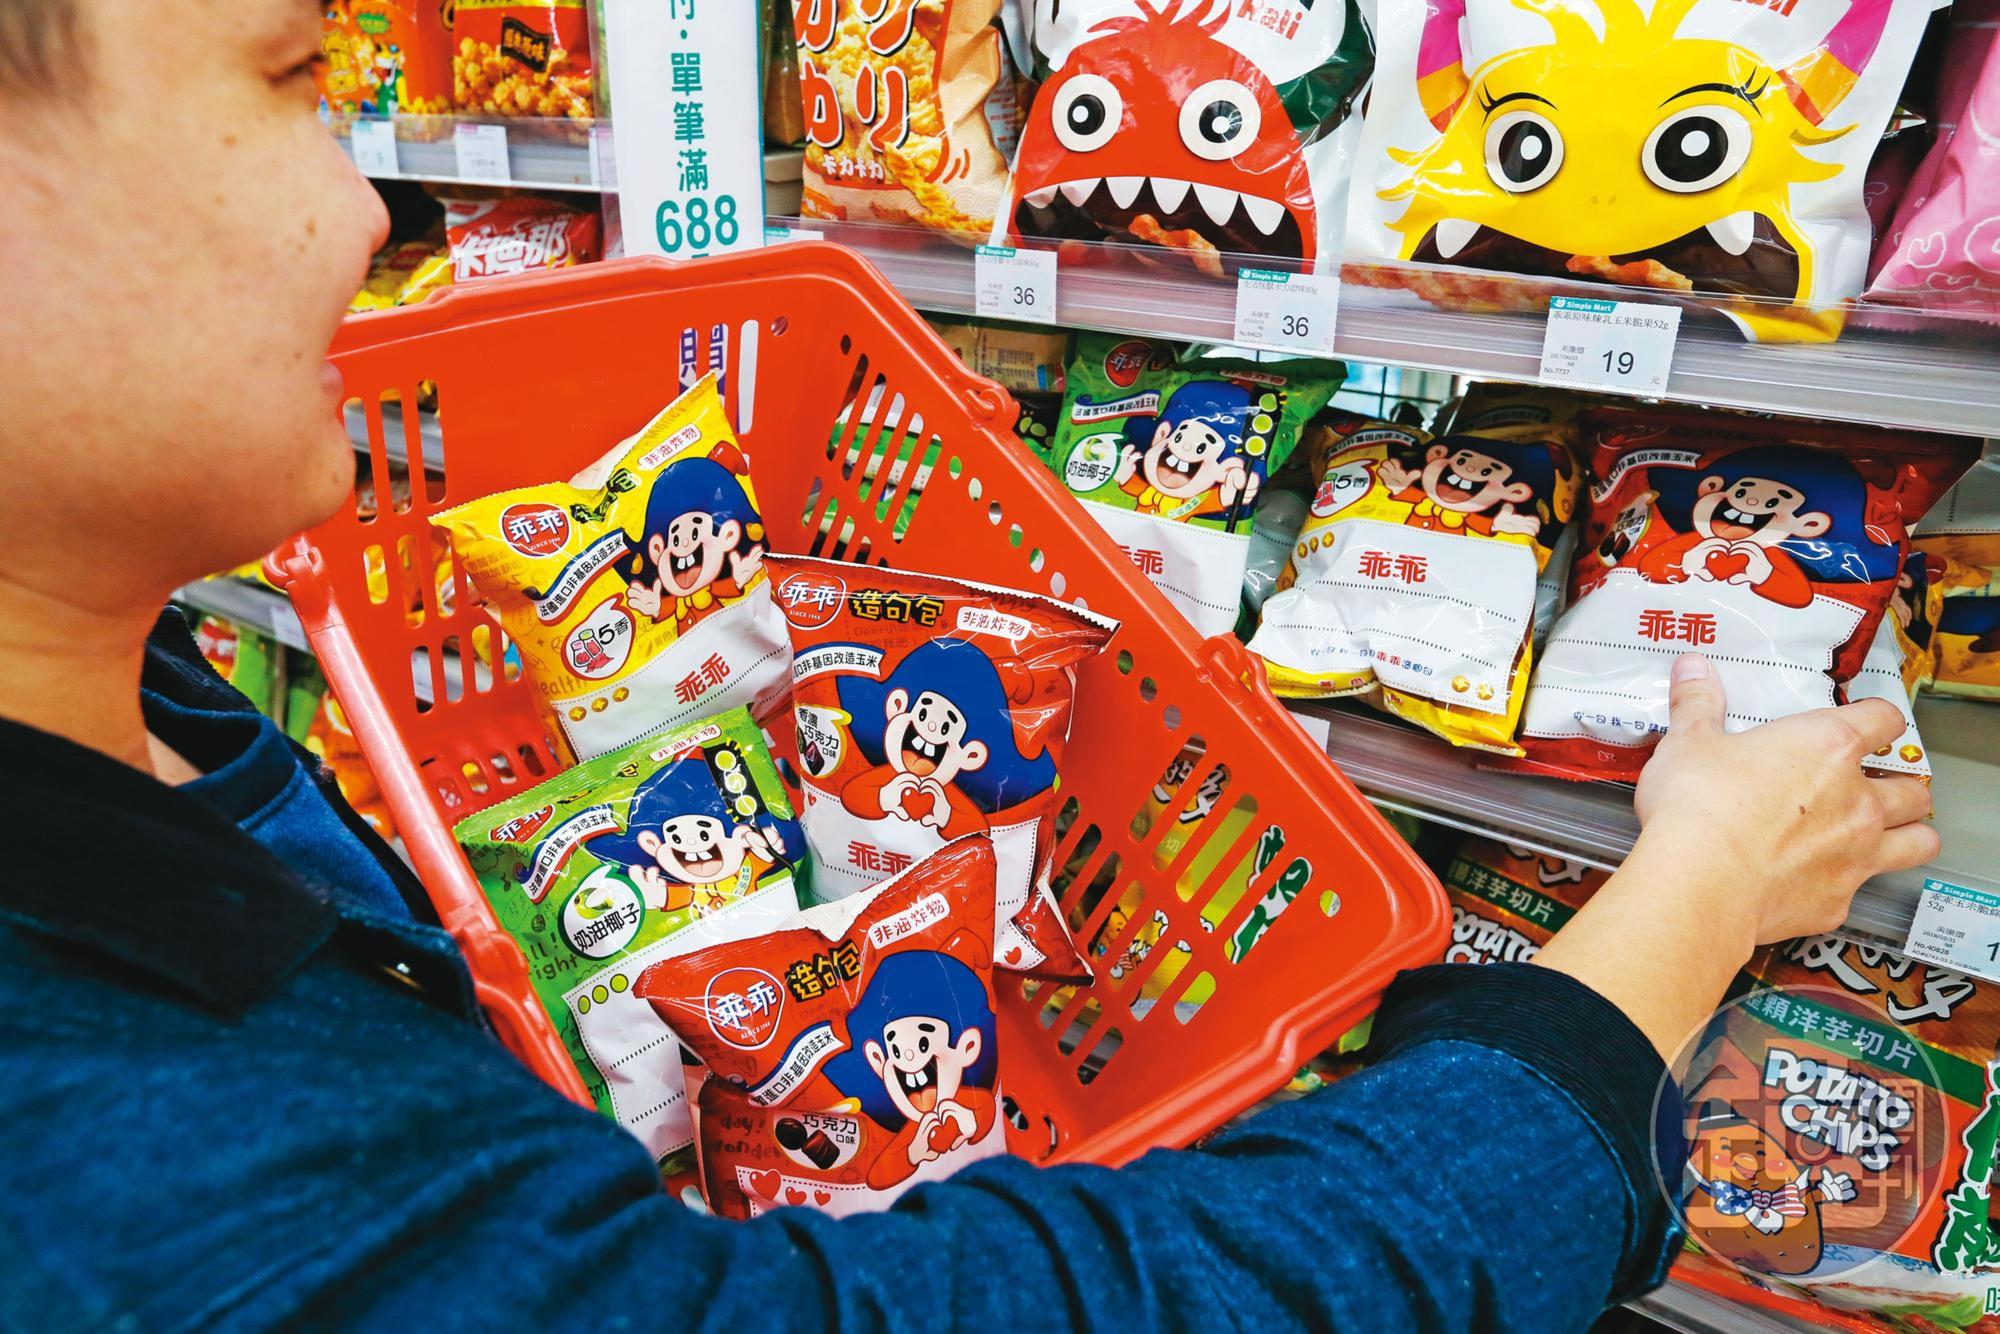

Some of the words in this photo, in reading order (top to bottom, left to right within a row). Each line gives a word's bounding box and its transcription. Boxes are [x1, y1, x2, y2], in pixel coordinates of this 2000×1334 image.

[822, 154, 884, 180] 卡力卡力
[655, 194, 739, 253] 688
[1013, 286, 1035, 305] 36
[1567, 301, 1592, 311] Simple
[1594, 303, 1612, 311] Mart
[1282, 315, 1309, 337] 36
[1602, 350, 1635, 375] 19
[644, 427, 698, 467] 非油炸物
[508, 509, 565, 544] 乖乖
[1358, 551, 1429, 584] 乖乖
[783, 582, 838, 611] 乖乖
[850, 589, 944, 626] 造句包
[600, 616, 630, 645] 5香
[1638, 609, 1718, 646] 乖乖
[674, 652, 732, 704] 乖乖
[794, 652, 878, 678] 口非基因改造玉米
[804, 725, 840, 750] 巧克力
[822, 747, 837, 759] 口味
[1943, 886, 1974, 900] Simple
[1975, 894, 1998, 906] Mart
[573, 902, 641, 952] 奶油椰子
[874, 897, 947, 943] 非油炸物
[529, 953, 578, 981] ight
[715, 980, 778, 1029] 乖乖
[1763, 1048, 1913, 1130] POTATO
[802, 1113, 858, 1135] 巧克力
[1780, 1093, 1901, 1171] CHIPS
[835, 1133, 857, 1145] 口味
